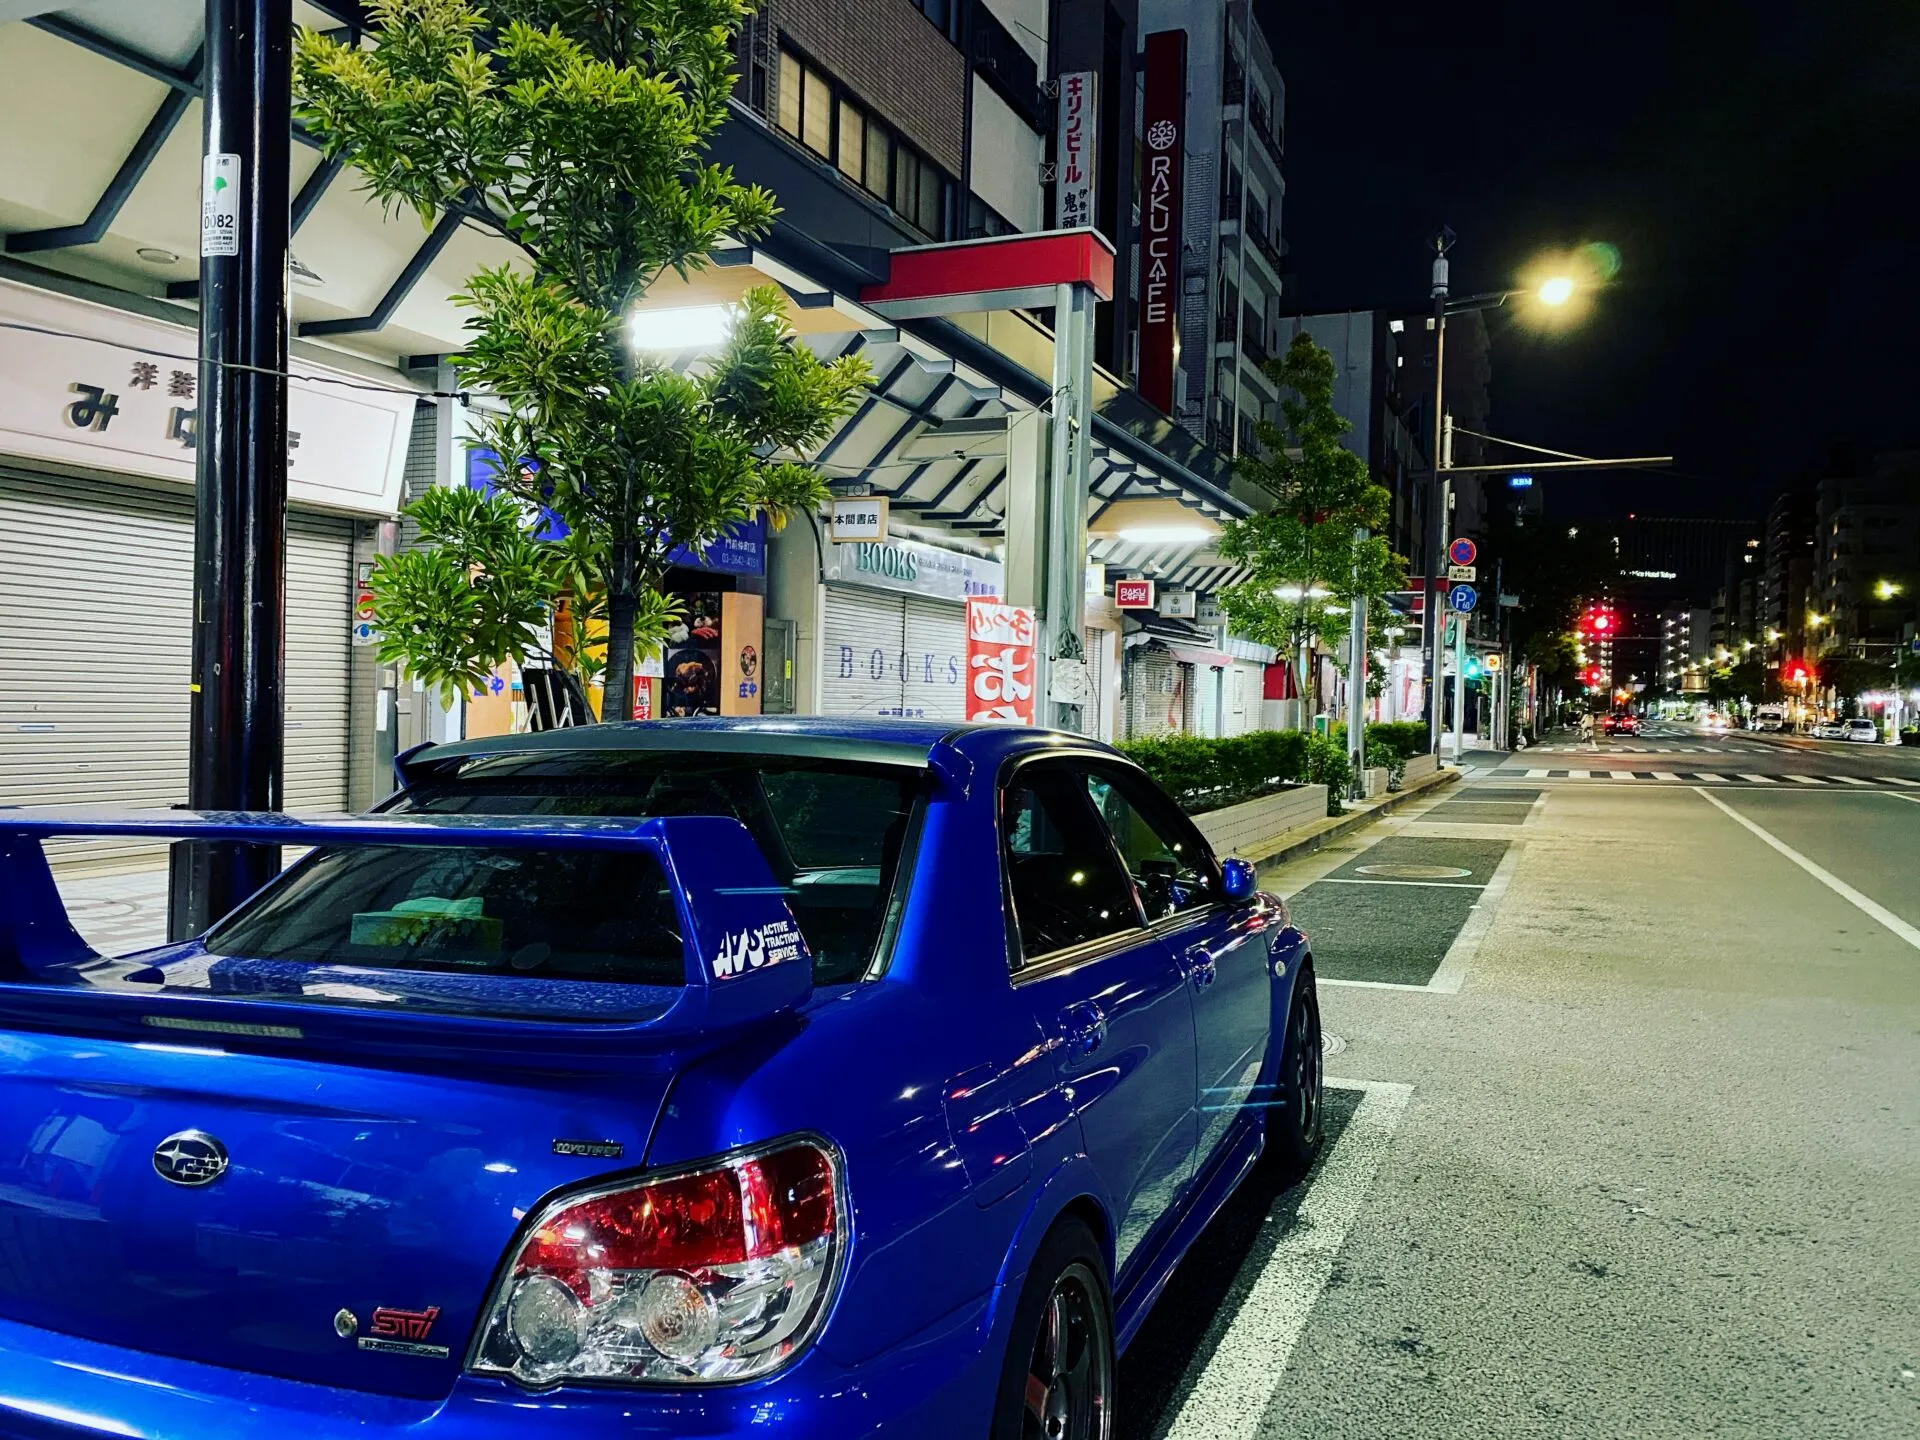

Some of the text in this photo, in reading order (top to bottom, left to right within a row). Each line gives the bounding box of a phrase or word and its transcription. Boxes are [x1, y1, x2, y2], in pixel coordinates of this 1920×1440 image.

[1064, 76, 1083, 184] キリンビール
[204, 214, 234, 229] 0082
[1147, 156, 1171, 323] RAKU CAFE
[834, 513, 878, 525] 本間書店
[856, 541, 918, 581] BOOKS
[1456, 592, 1467, 609] P
[739, 682, 758, 698] 庄や
[763, 920, 789, 936] ACTIVE
[765, 931, 800, 949] TRACTION
[768, 944, 798, 960] SERVICE
[556, 1142, 586, 1154] TOYO
